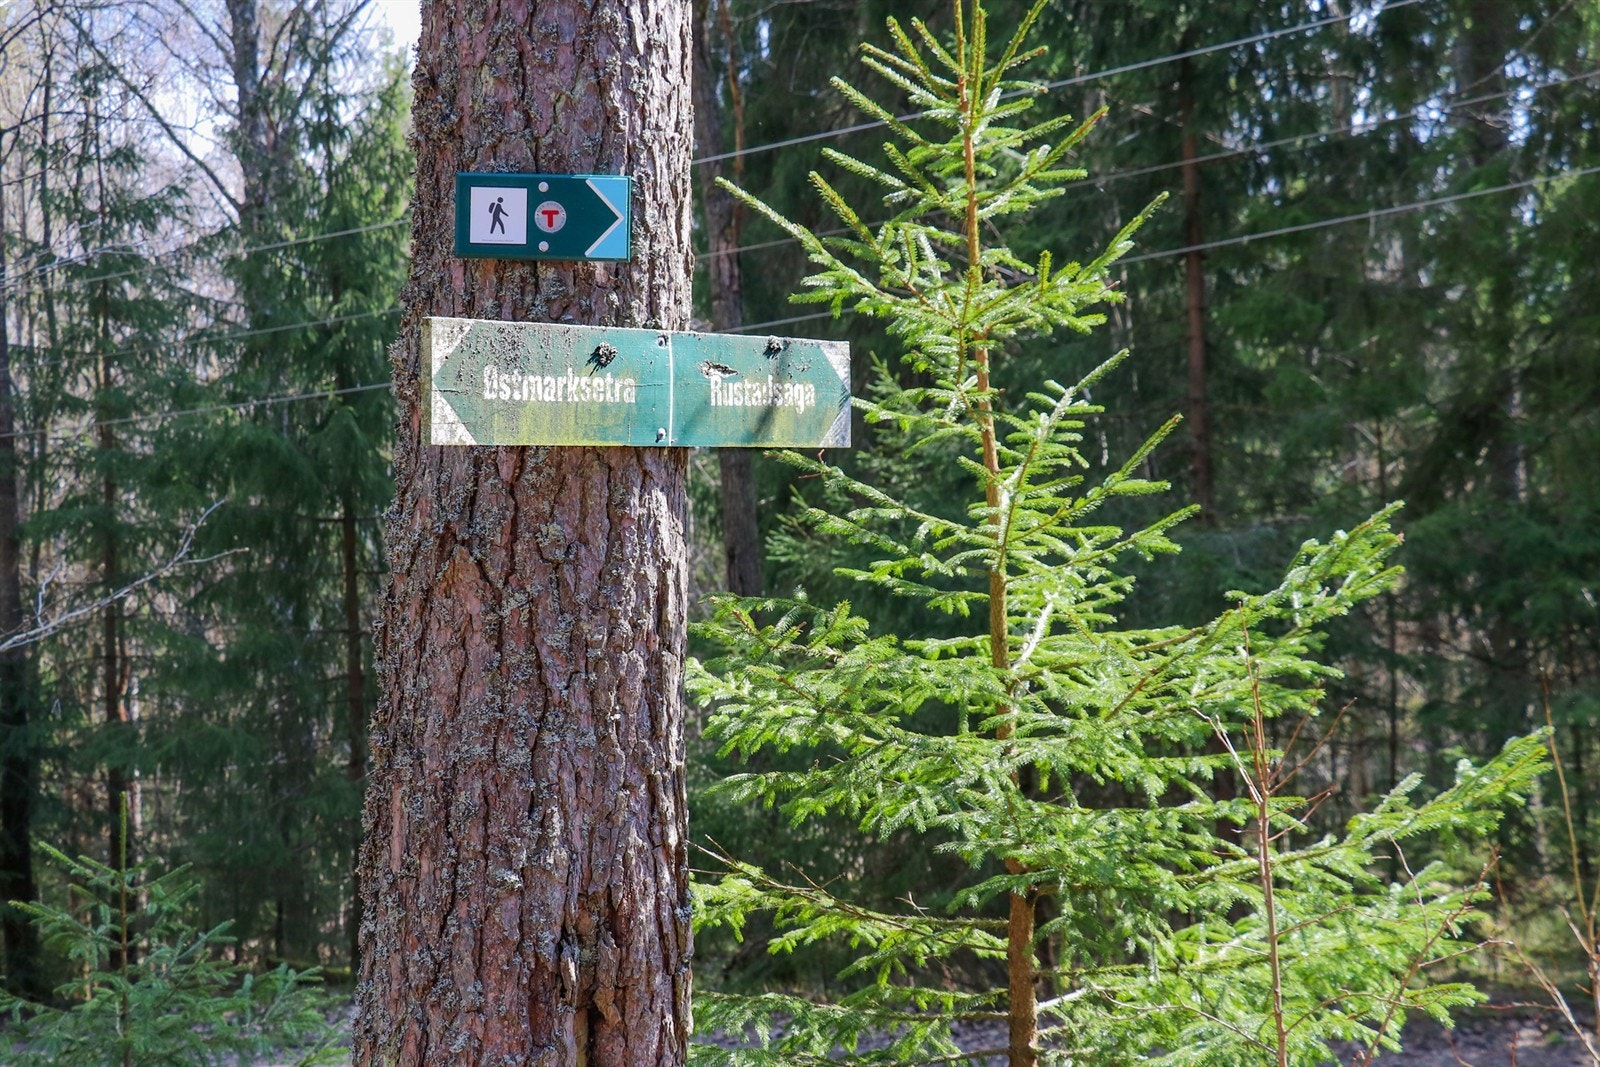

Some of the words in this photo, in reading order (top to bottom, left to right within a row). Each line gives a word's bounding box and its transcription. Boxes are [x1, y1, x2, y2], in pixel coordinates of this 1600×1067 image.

[541, 210, 560, 228] T
[483, 365, 636, 403] Østmarksetra
[710, 375, 816, 414] Rustadsaga
